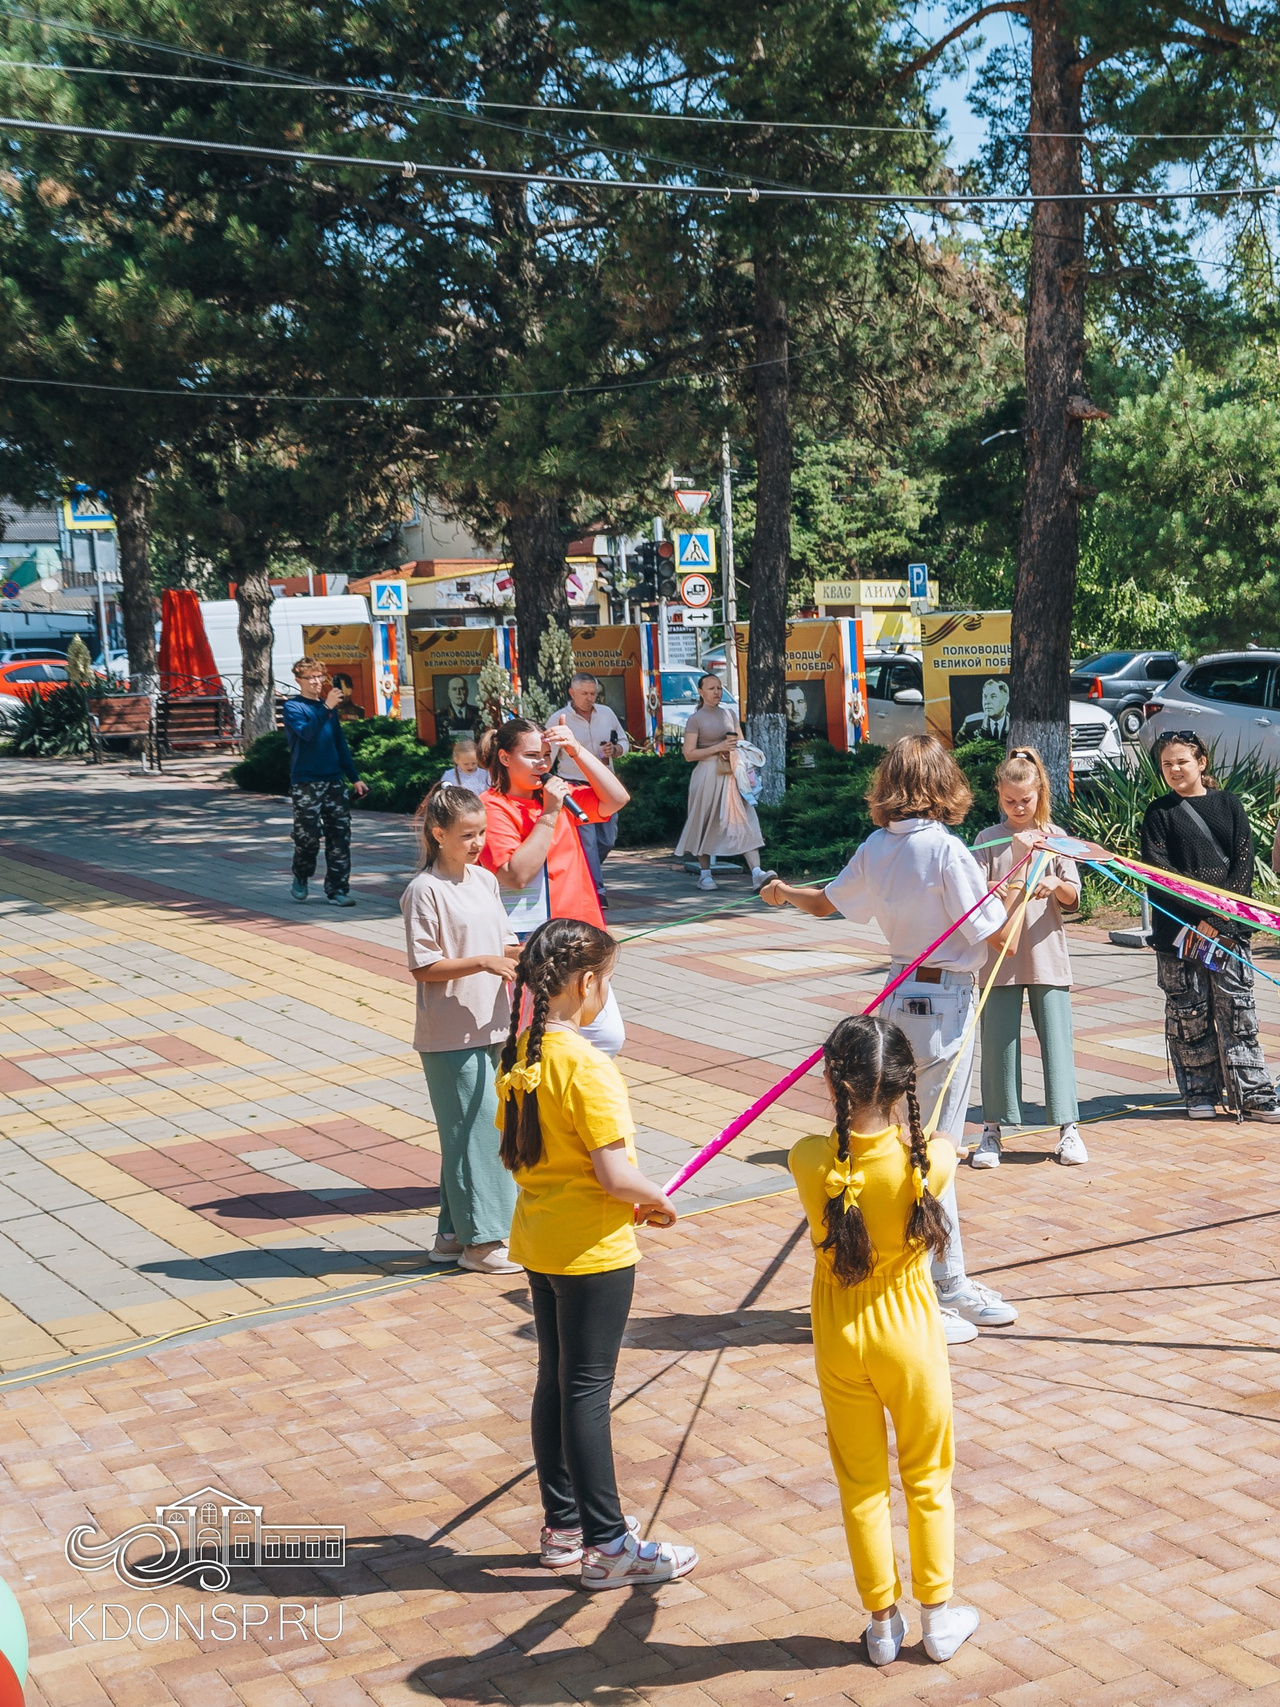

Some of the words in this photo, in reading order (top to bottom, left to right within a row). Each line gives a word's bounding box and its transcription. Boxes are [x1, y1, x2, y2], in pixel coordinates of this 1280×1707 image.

[913, 567, 924, 595] P
[822, 585, 852, 599] КВАС
[865, 585, 935, 600] ЛИМО
[430, 650, 482, 658] ПОЛКОВОДЦЫ
[573, 650, 622, 658] ЛКОВОДЦЫ
[424, 659, 458, 667] ВЕЛИКОЙ
[460, 659, 488, 667] ПОБЕД
[598, 659, 634, 668] ПОБЕДЫ
[795, 661, 834, 671] ПОБЕДЫ
[933, 657, 982, 668] ВЕЛИКОЙ
[985, 657, 1012, 667] ПОБЕ
